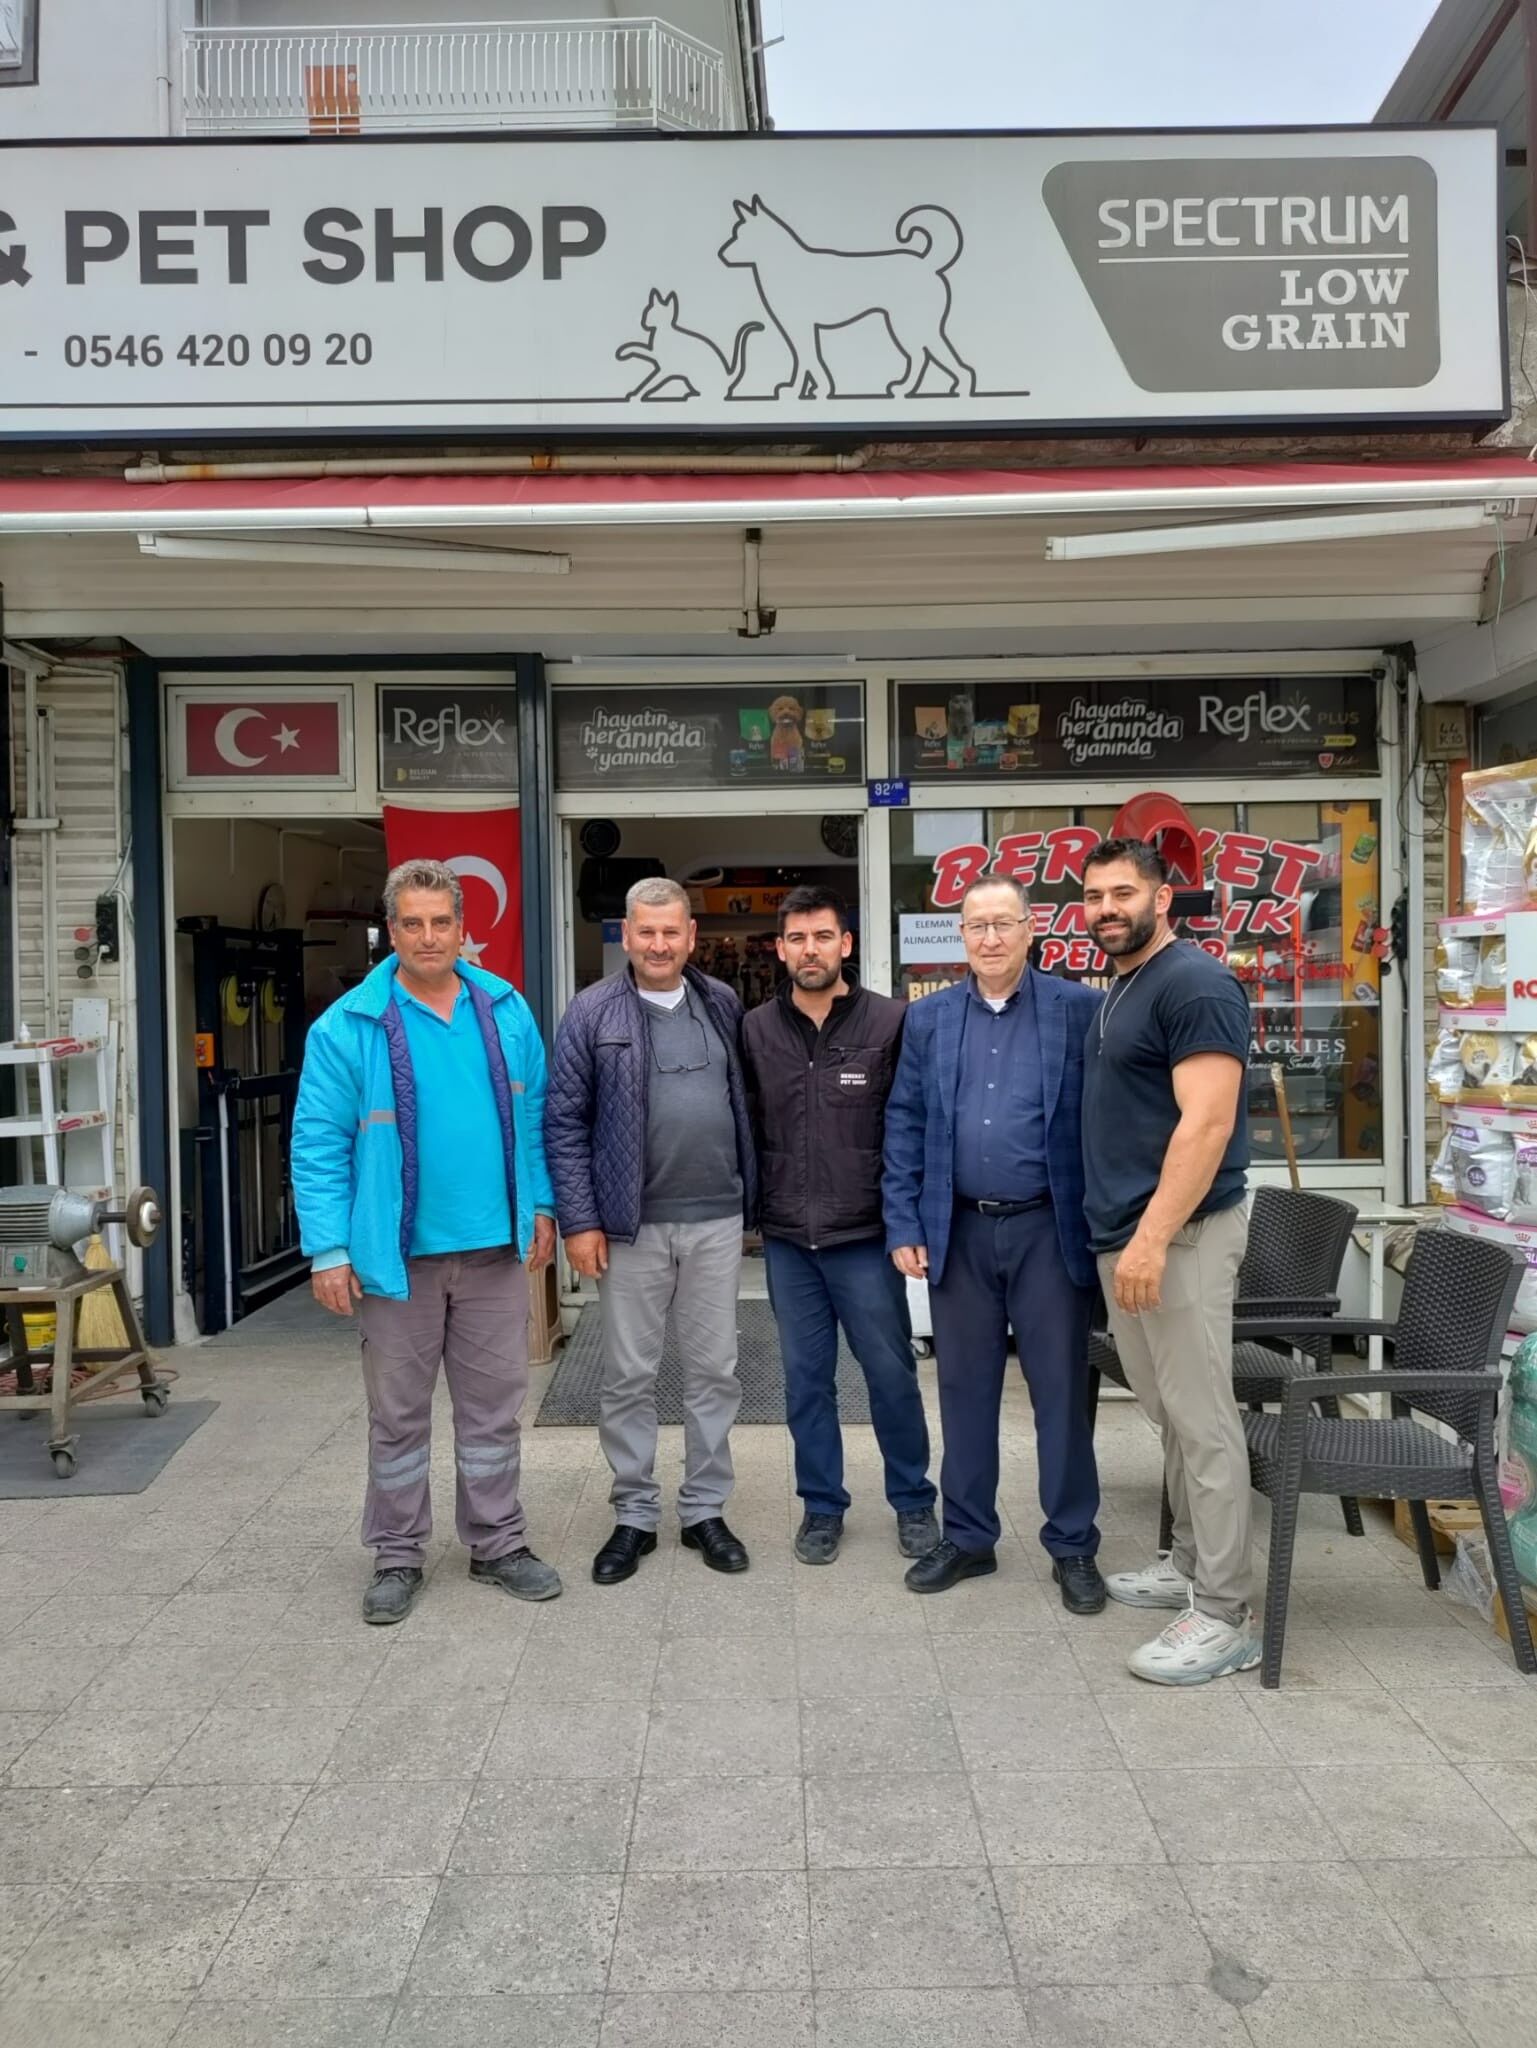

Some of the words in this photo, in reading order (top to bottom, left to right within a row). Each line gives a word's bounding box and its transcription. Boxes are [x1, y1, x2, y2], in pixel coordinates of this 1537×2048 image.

[1098, 195, 1409, 249] SPECTRUM
[65, 210, 270, 285] PET
[303, 205, 606, 285] SHOP
[1280, 269, 1409, 309] LOW
[1222, 312, 1409, 353] GRAIN
[64, 335, 163, 367] 0546
[177, 335, 250, 366] 420
[263, 334, 311, 366] 09
[325, 333, 372, 366] 20
[597, 710, 668, 732] hayatın
[1061, 717, 1095, 737] her
[1093, 714, 1179, 739] anında
[1074, 701, 1146, 723] hayatın
[1198, 691, 1312, 743] Reflex
[1318, 711, 1360, 725] PLUS
[393, 703, 506, 754] Reflex
[584, 726, 618, 746] her
[616, 724, 701, 749] anında
[599, 747, 675, 771] yanında
[1075, 737, 1152, 762] yanında
[915, 920, 953, 929] ELEMAN
